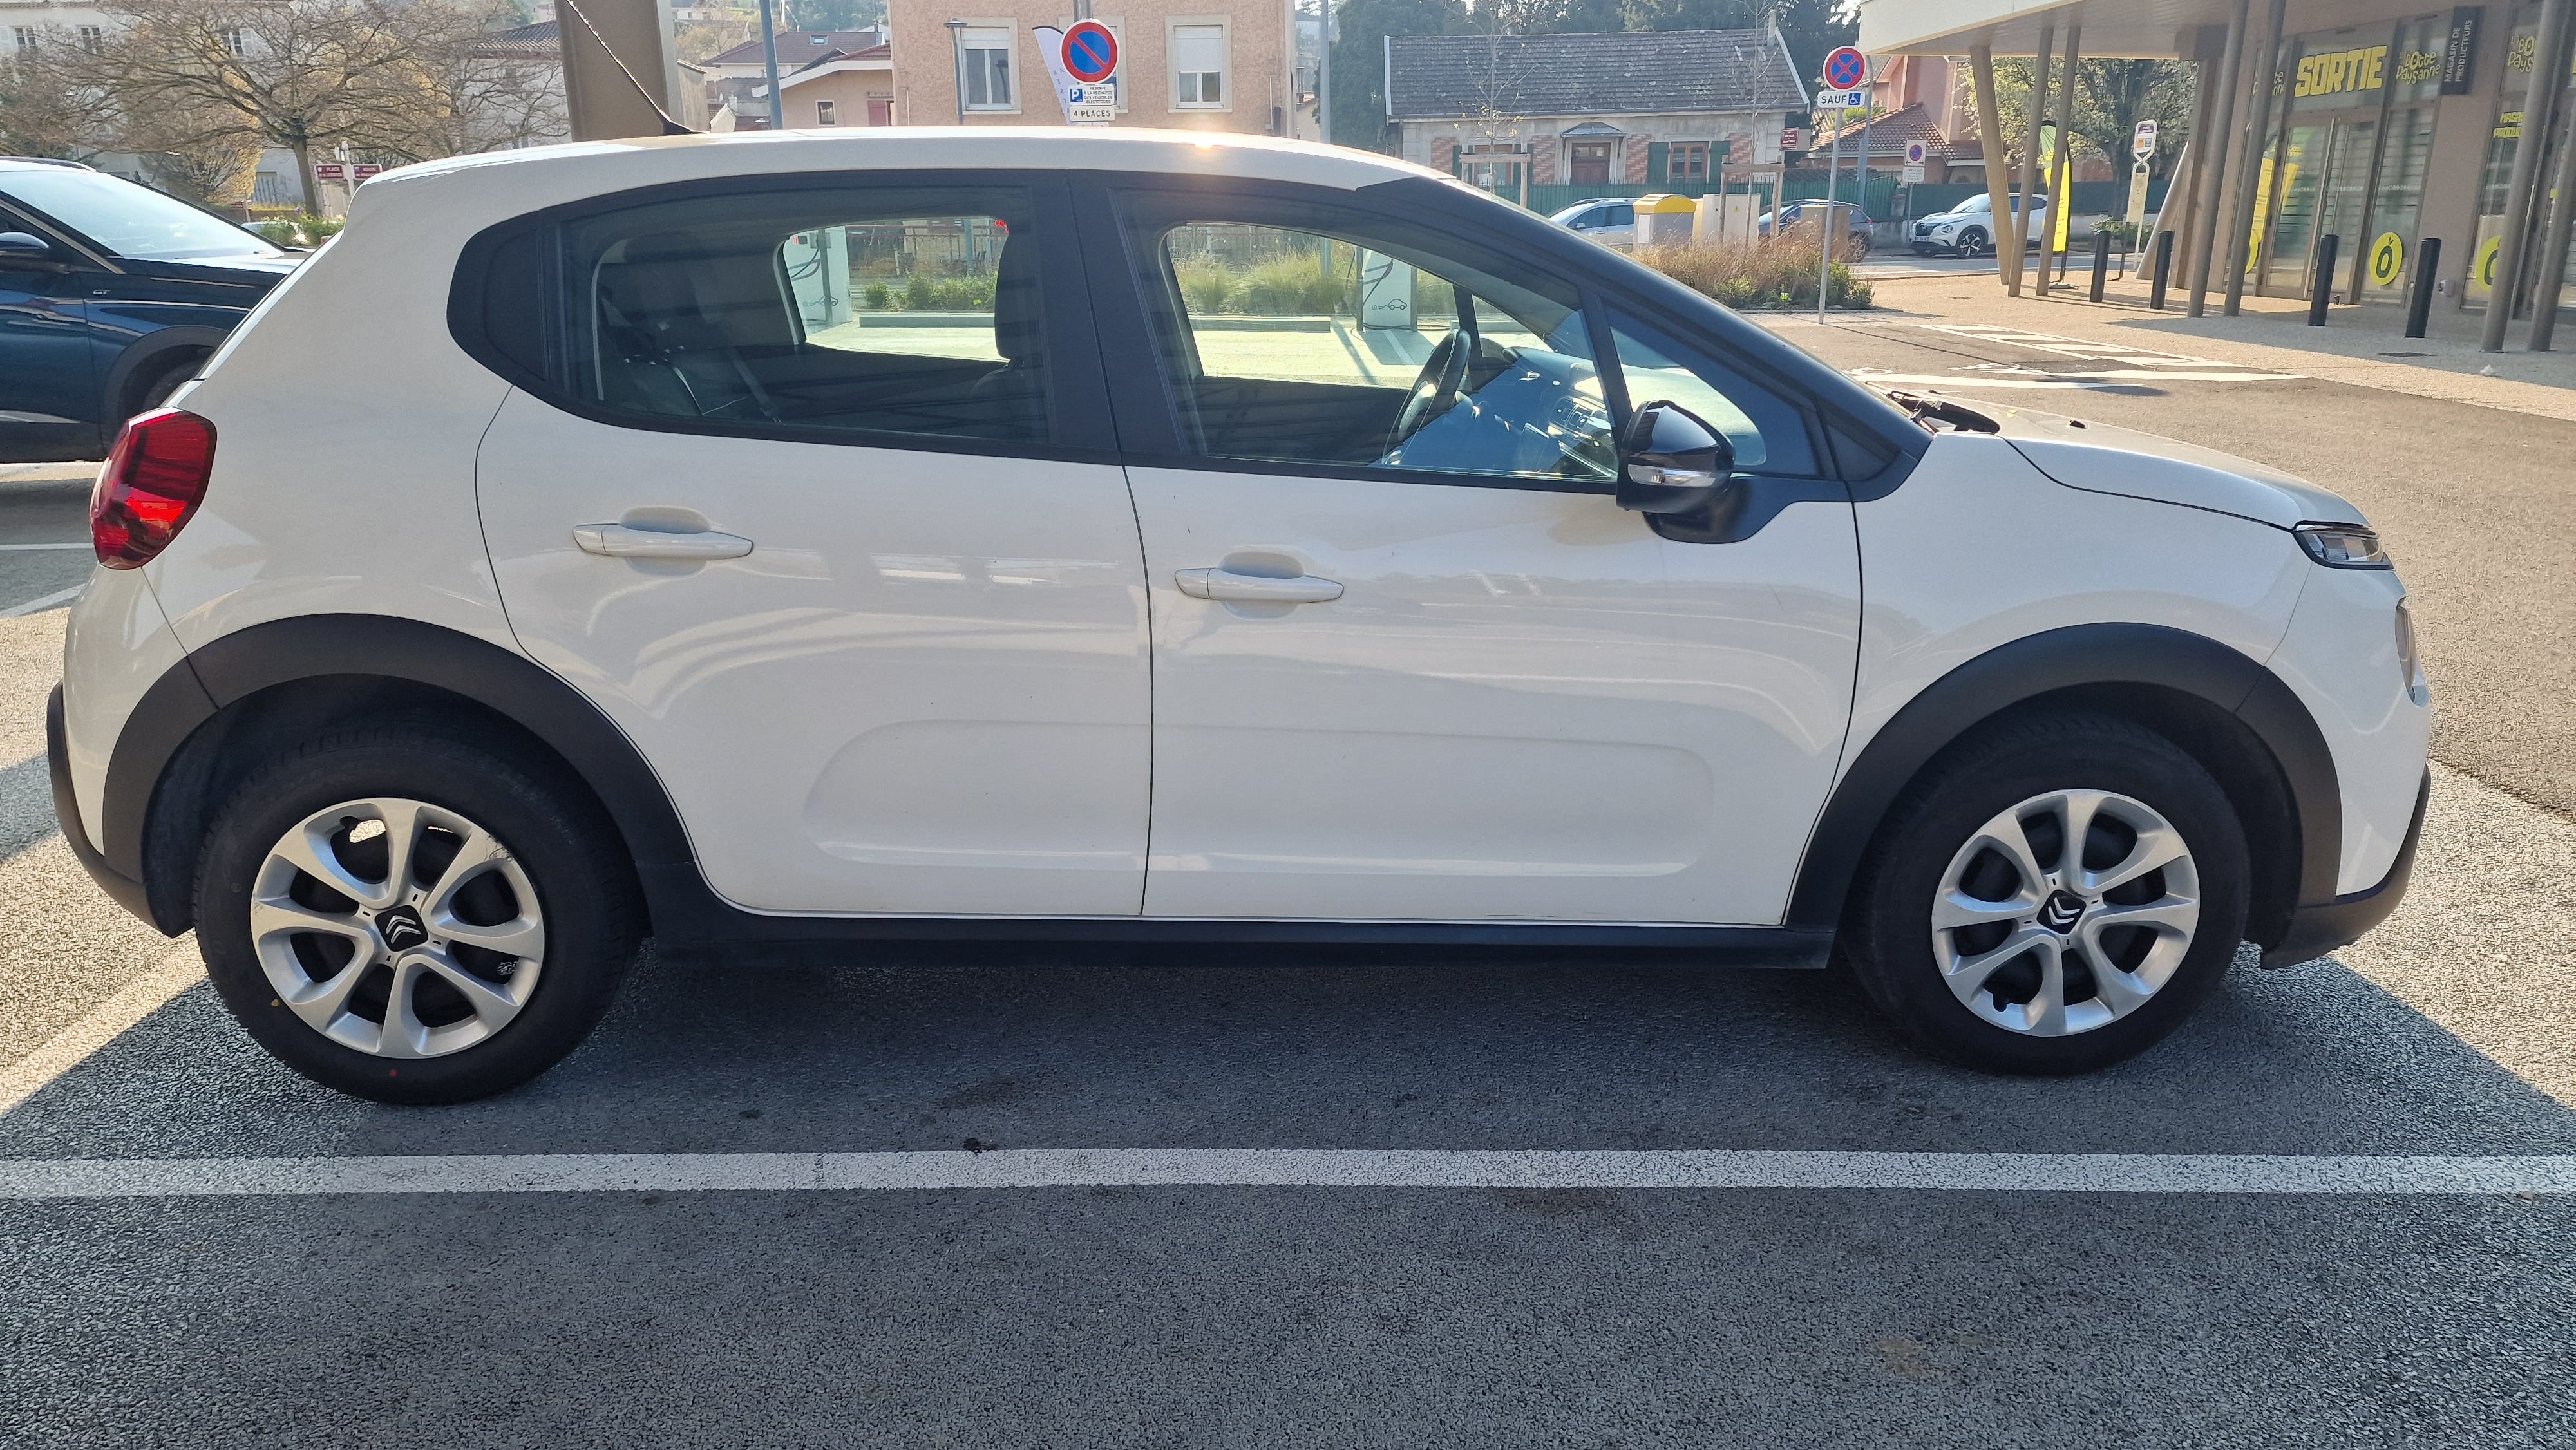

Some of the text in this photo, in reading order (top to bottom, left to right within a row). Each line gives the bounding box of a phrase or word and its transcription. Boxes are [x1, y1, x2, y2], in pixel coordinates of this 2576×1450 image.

[2294, 45, 2388, 97] SORTIE
[2396, 64, 2441, 84] Paysanne
[2444, 27, 2460, 82] MAGASIN DE
[2455, 19, 2472, 82] PRODUCTEURS
[1821, 95, 1847, 104] SAUF
